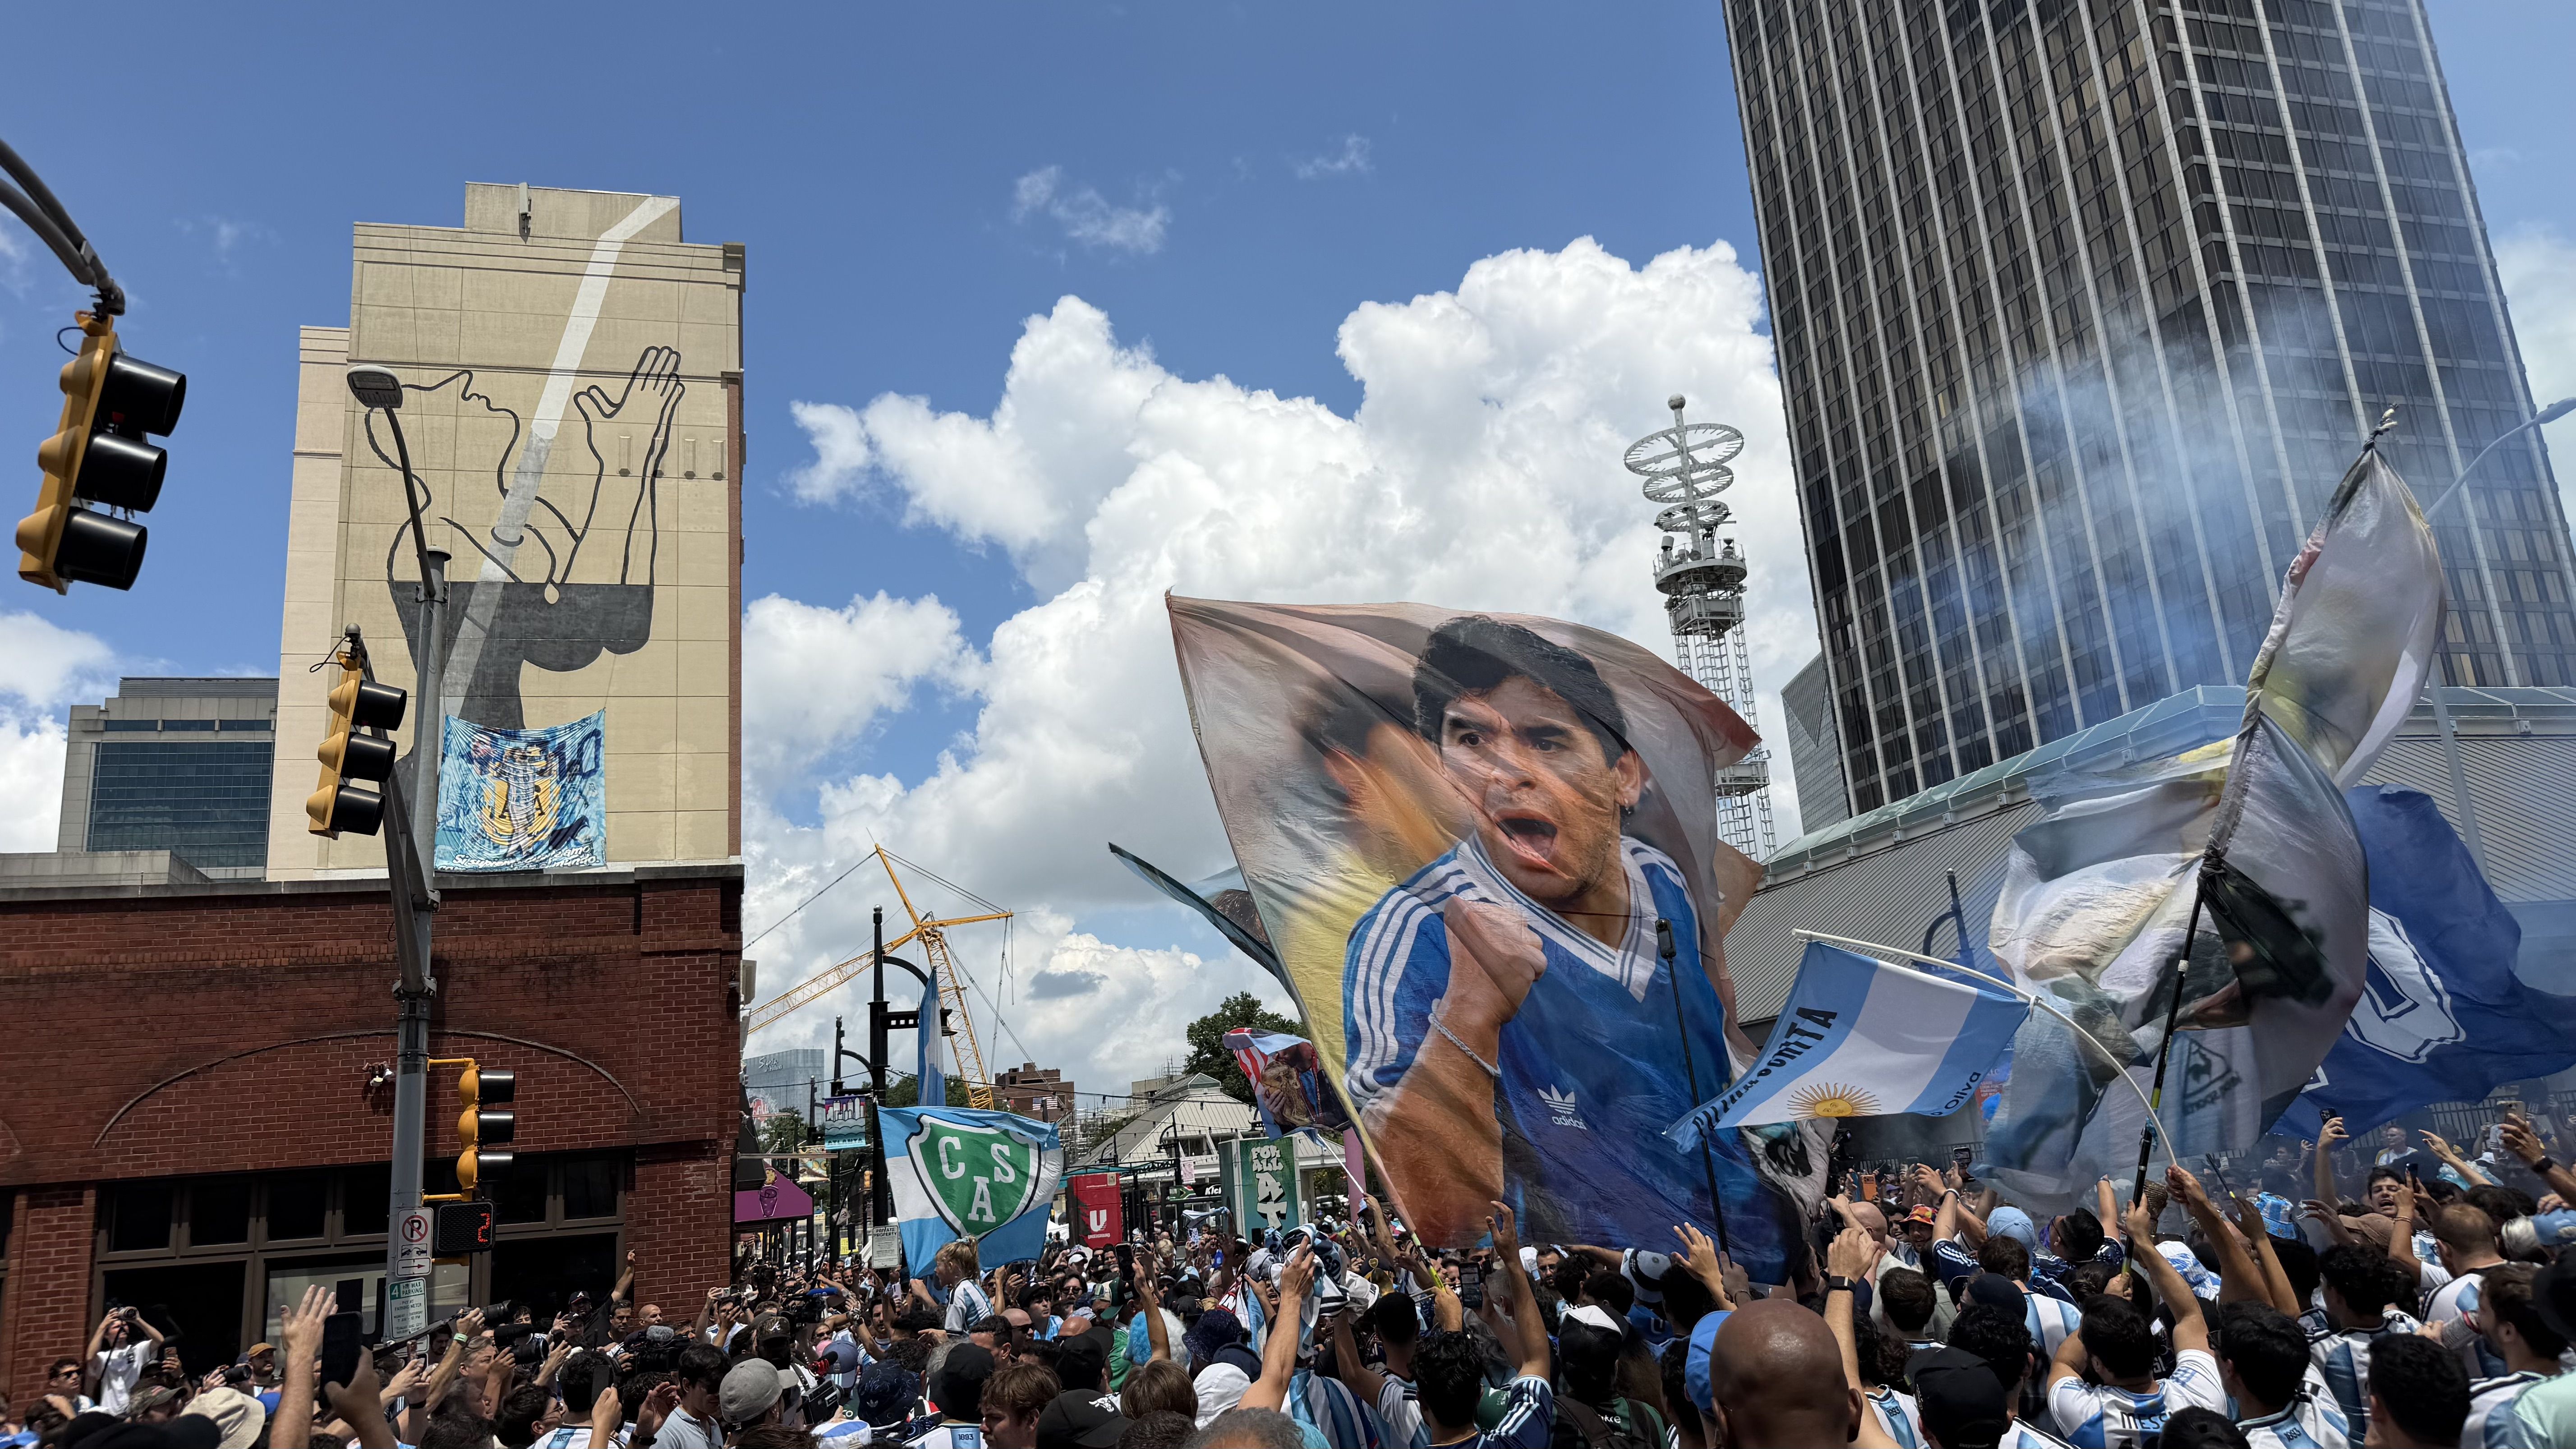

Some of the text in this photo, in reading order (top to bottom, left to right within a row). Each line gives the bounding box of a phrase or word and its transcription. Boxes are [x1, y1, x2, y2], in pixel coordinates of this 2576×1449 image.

[1944, 1072, 1981, 1109] Oliva
[1251, 1145, 1281, 1159] FOR
[1252, 1157, 1284, 1172] ALL
[391, 1285, 399, 1298] 4
